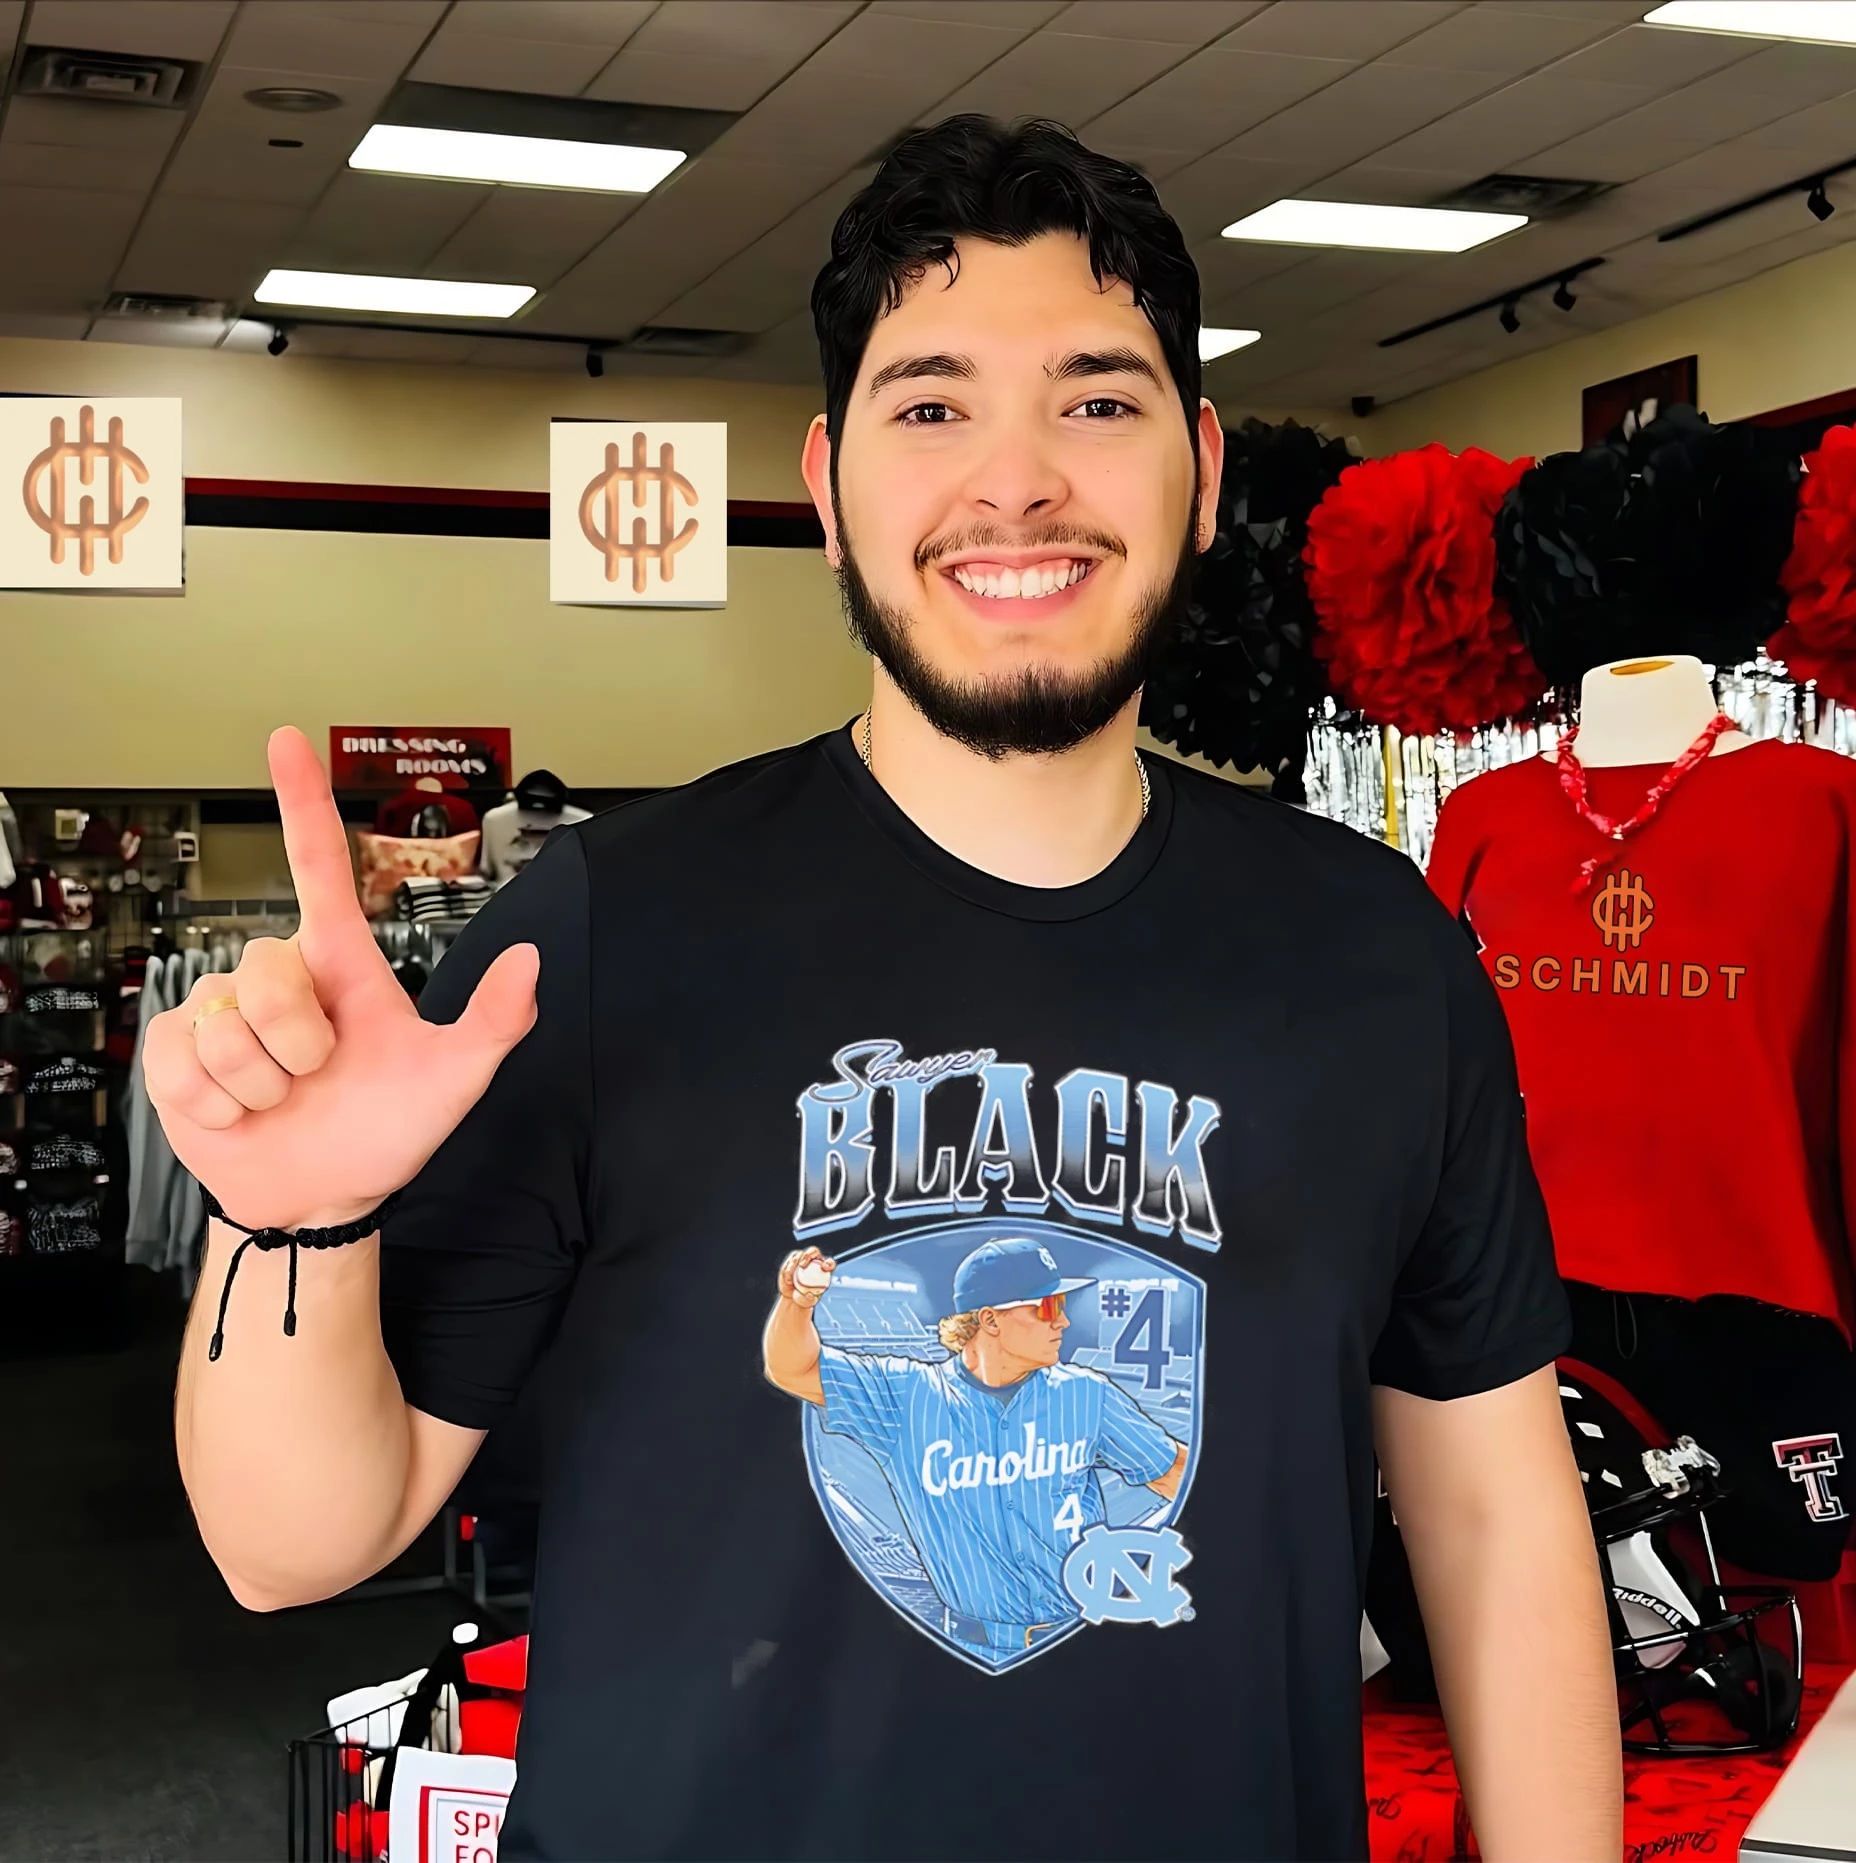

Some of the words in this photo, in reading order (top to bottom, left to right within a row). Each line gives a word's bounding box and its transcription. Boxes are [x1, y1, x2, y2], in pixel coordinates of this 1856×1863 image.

[342, 737, 466, 754] DRESSING
[396, 758, 487, 775] ROOMS
[1494, 954, 1746, 1000] SCHMIDT
[808, 1038, 998, 1102] Sawyer
[793, 1063, 1222, 1254] BLACK
[1101, 1287, 1172, 1391] #4
[921, 1421, 1088, 1497] Carolina
[1054, 1493, 1084, 1544] 4
